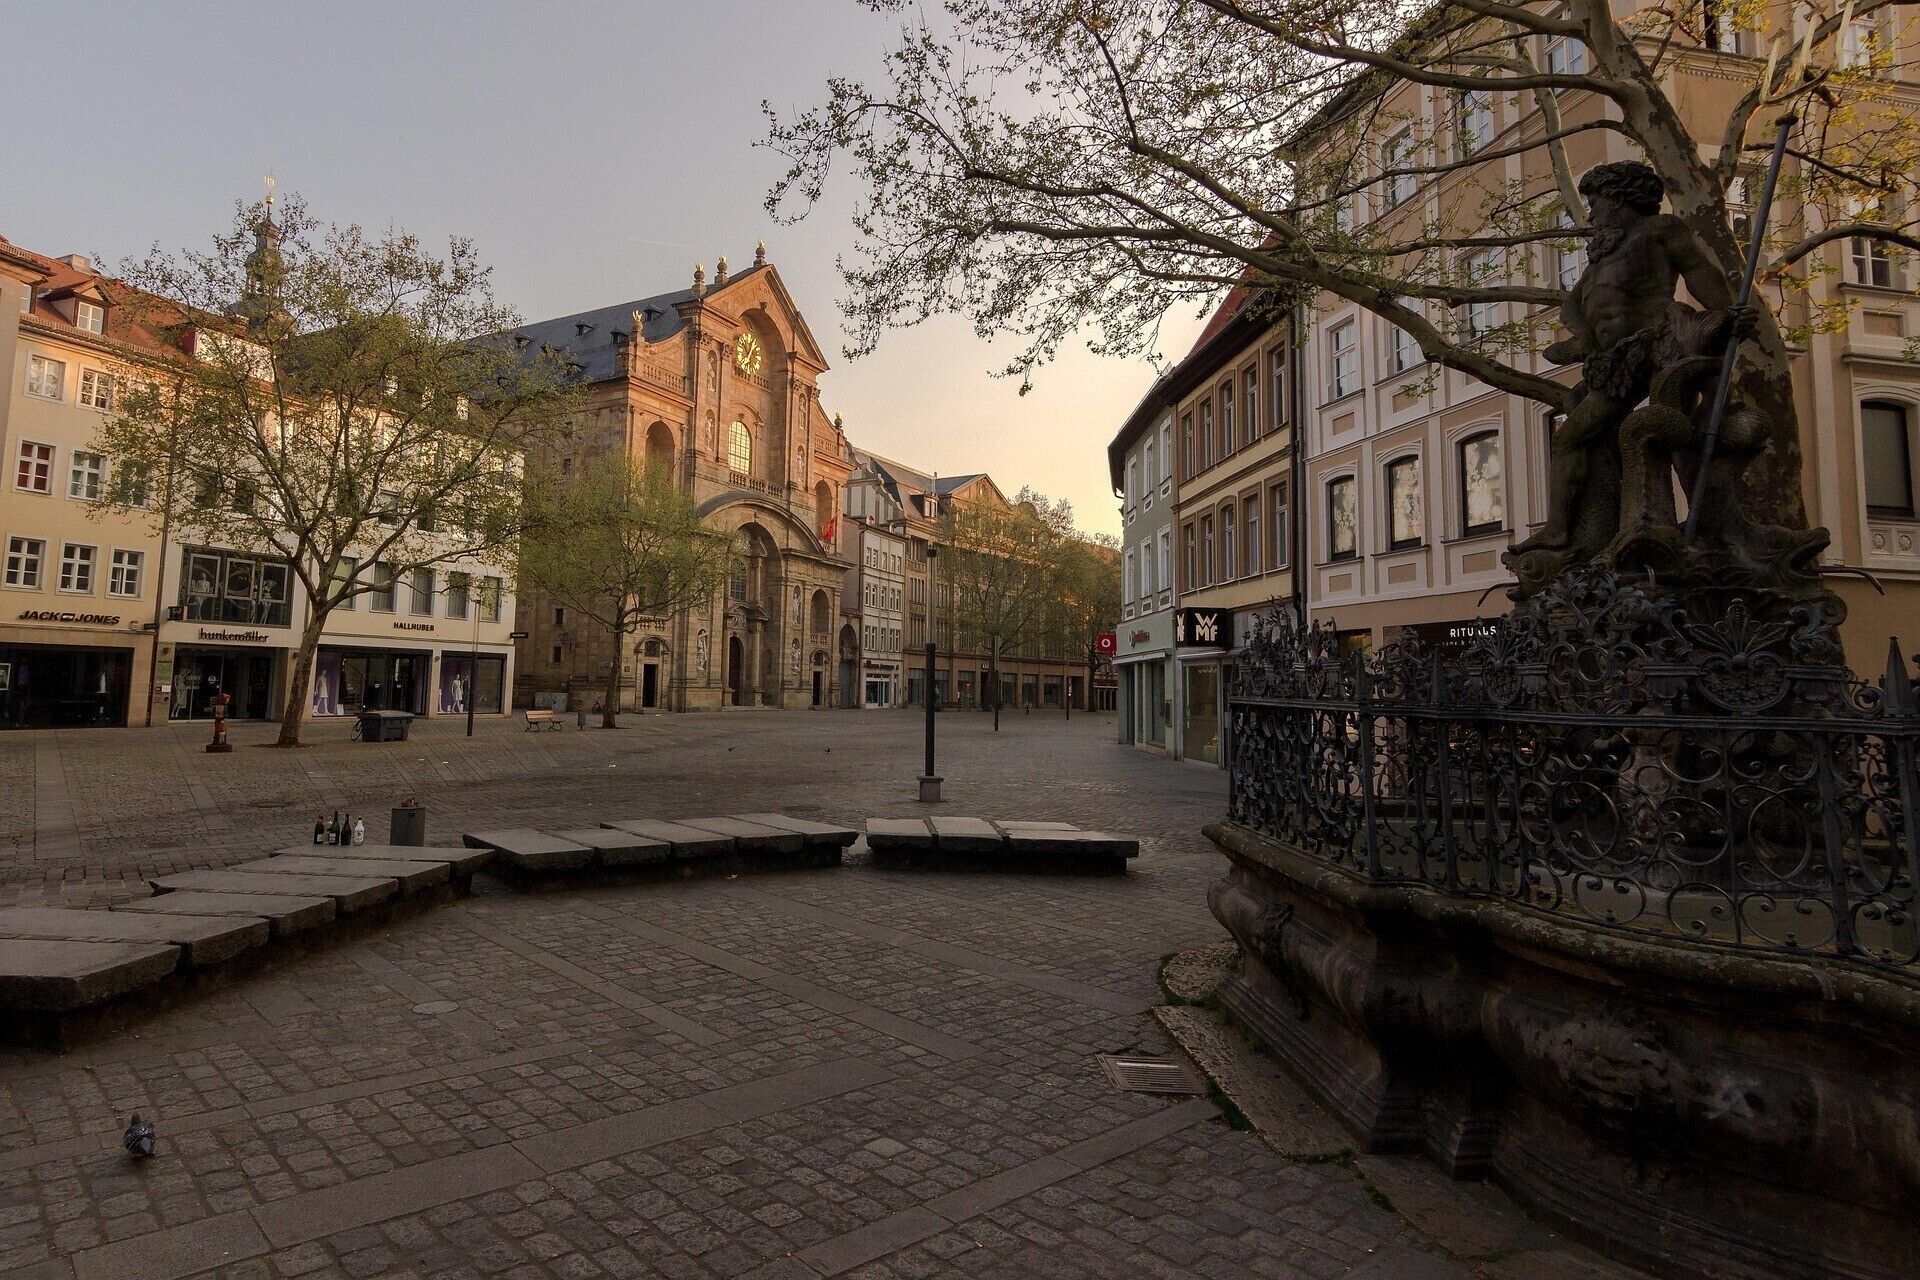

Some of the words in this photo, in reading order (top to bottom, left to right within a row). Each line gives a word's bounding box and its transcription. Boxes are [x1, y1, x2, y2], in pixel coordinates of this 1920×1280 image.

[19, 610, 60, 620] JACK
[74, 613, 121, 624] JONES
[393, 621, 435, 632] HALLHUBER
[1194, 612, 1218, 642] WMF
